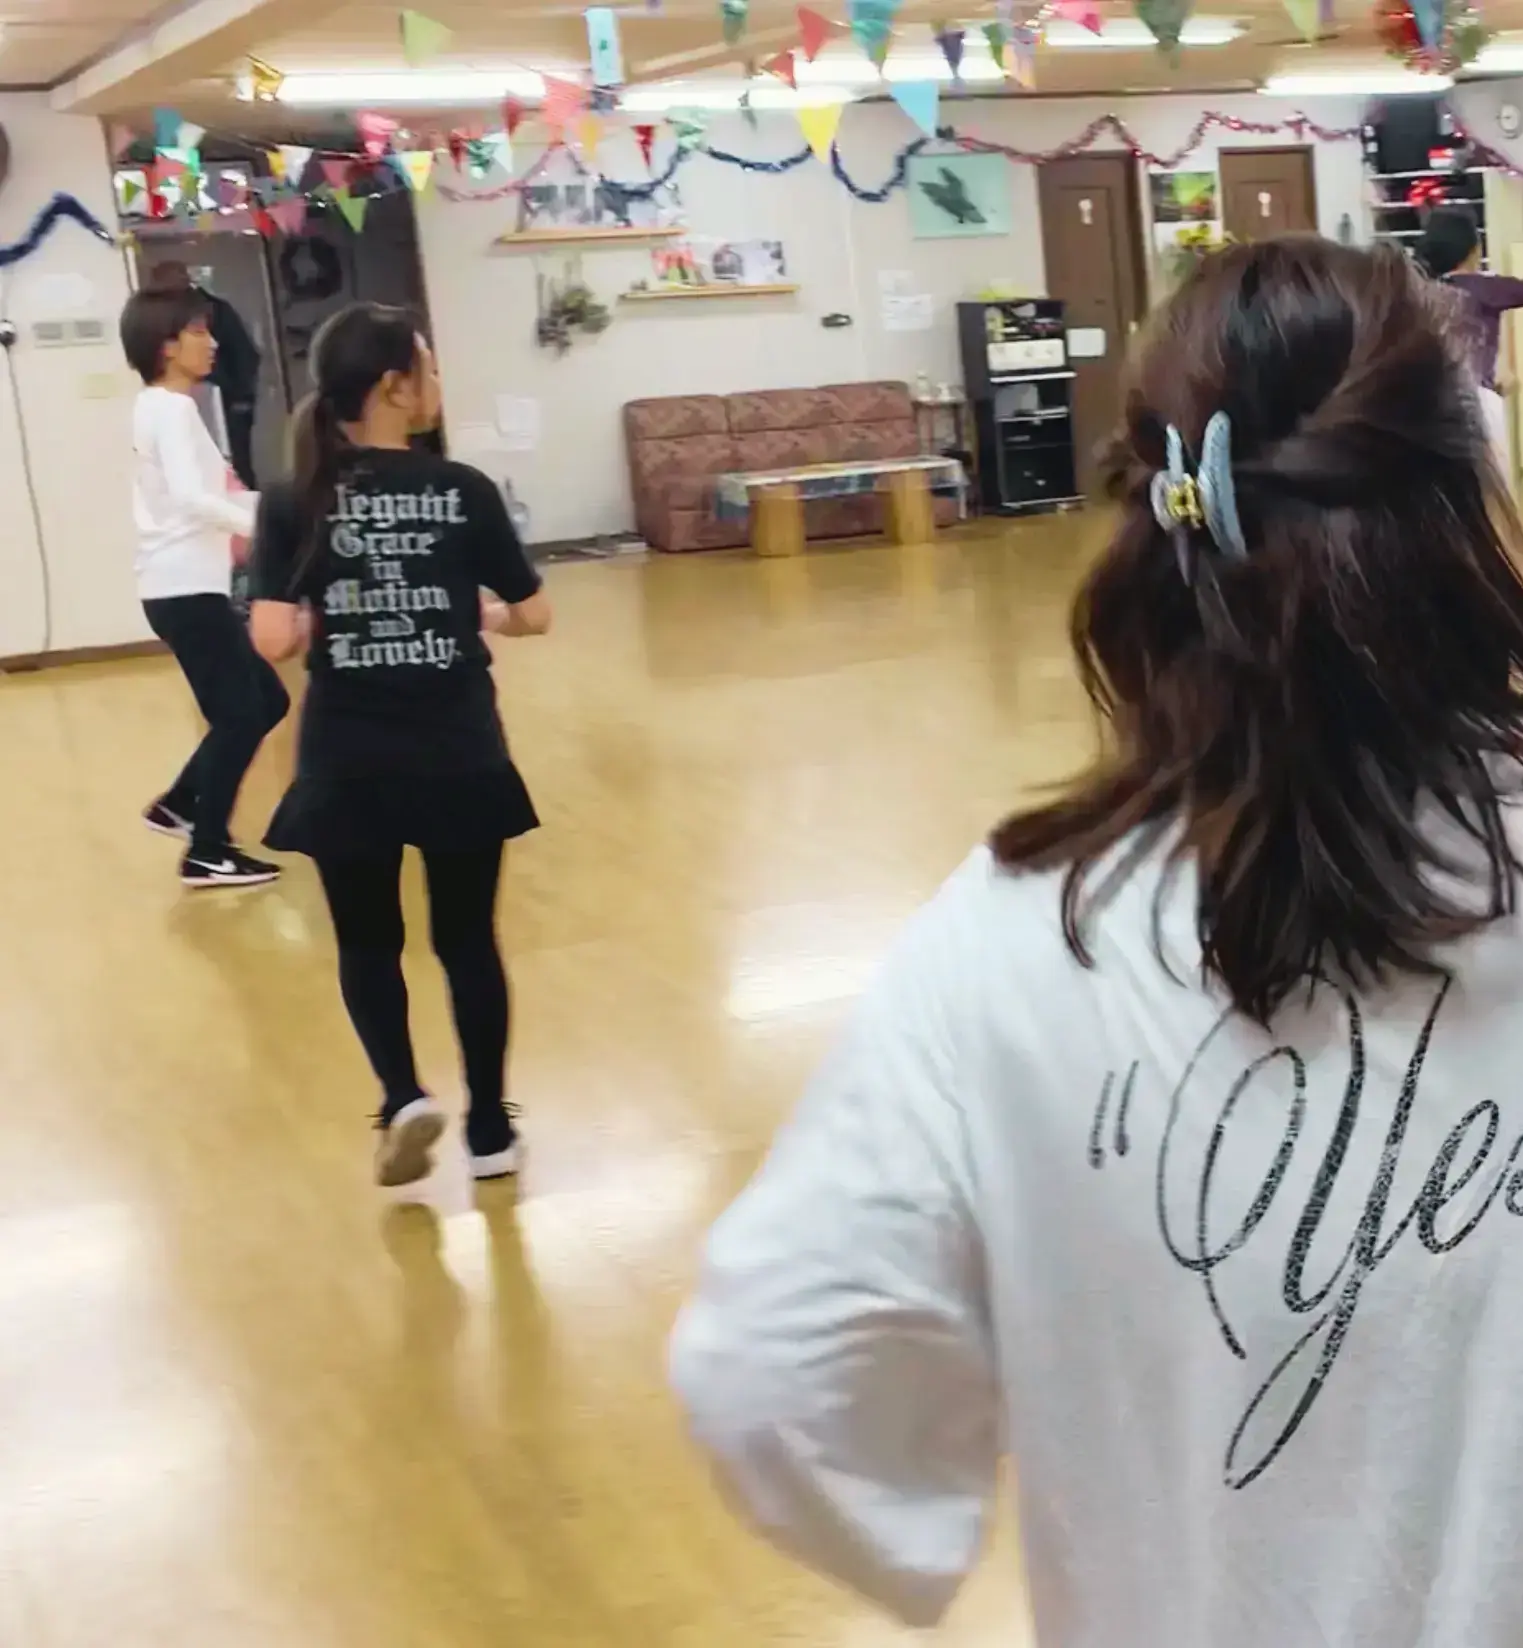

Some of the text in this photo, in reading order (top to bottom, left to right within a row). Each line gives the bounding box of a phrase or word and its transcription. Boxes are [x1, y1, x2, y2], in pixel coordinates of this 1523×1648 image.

[325, 483, 468, 528] legant
[330, 522, 436, 558] Grace
[369, 555, 404, 580] in
[324, 578, 451, 615] Motion
[369, 612, 416, 638] and
